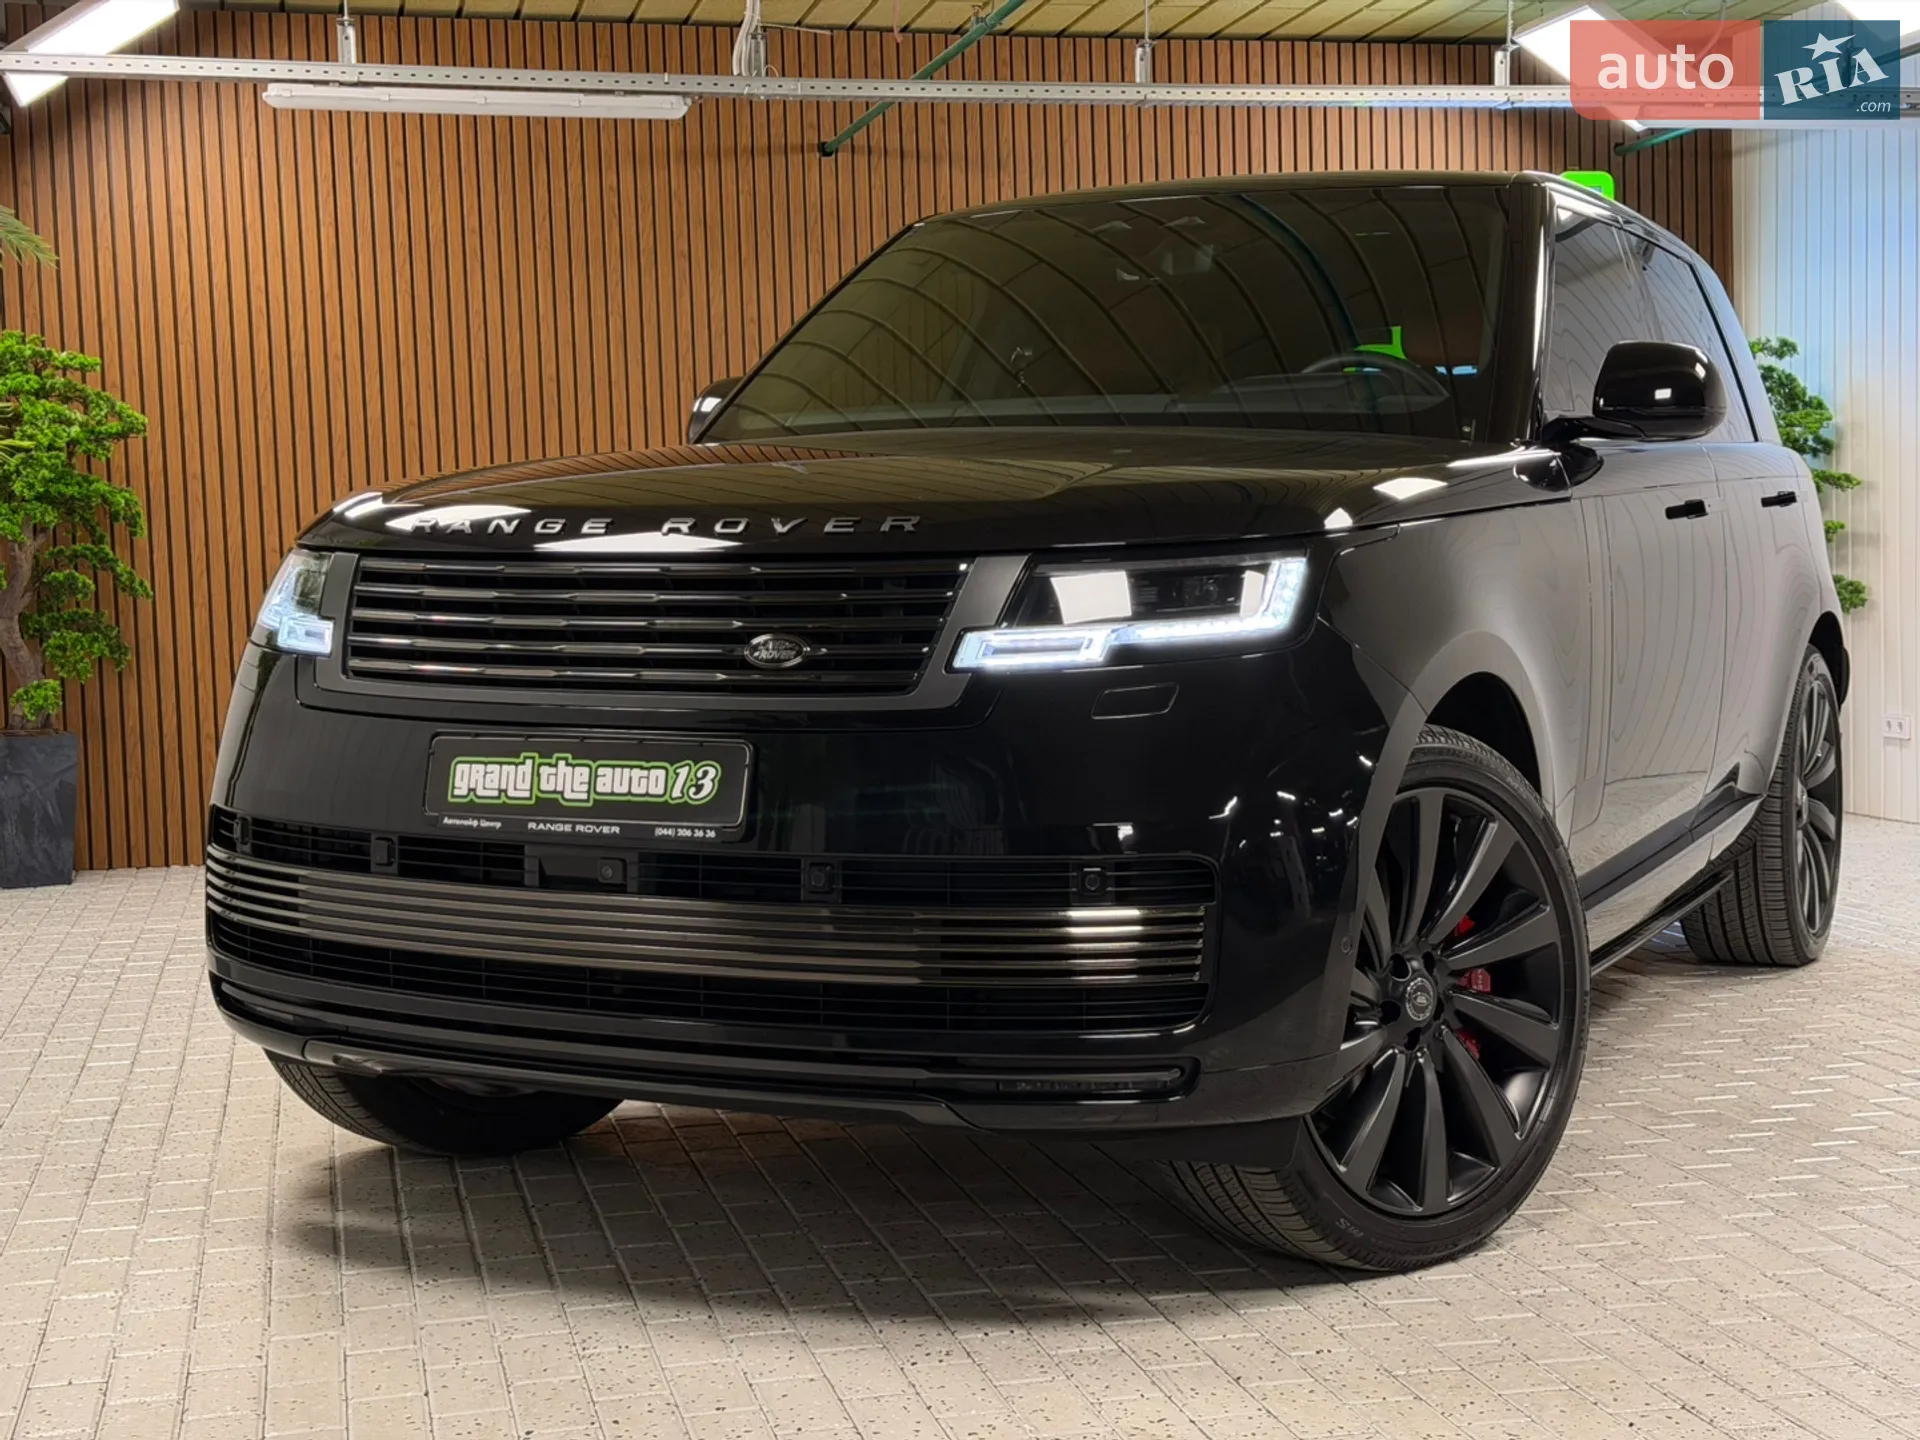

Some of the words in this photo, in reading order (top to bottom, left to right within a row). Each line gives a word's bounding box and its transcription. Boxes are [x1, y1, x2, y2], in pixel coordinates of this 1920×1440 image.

[409, 516, 614, 536] RANGE
[660, 515, 921, 535] ROVER
[539, 760, 590, 800] the
[527, 822, 573, 833] RANGE
[575, 824, 620, 835] ROVER
[654, 827, 676, 838] (044)
[677, 828, 693, 838] 206
[693, 829, 704, 838] 36
[705, 829, 716, 839] 36
